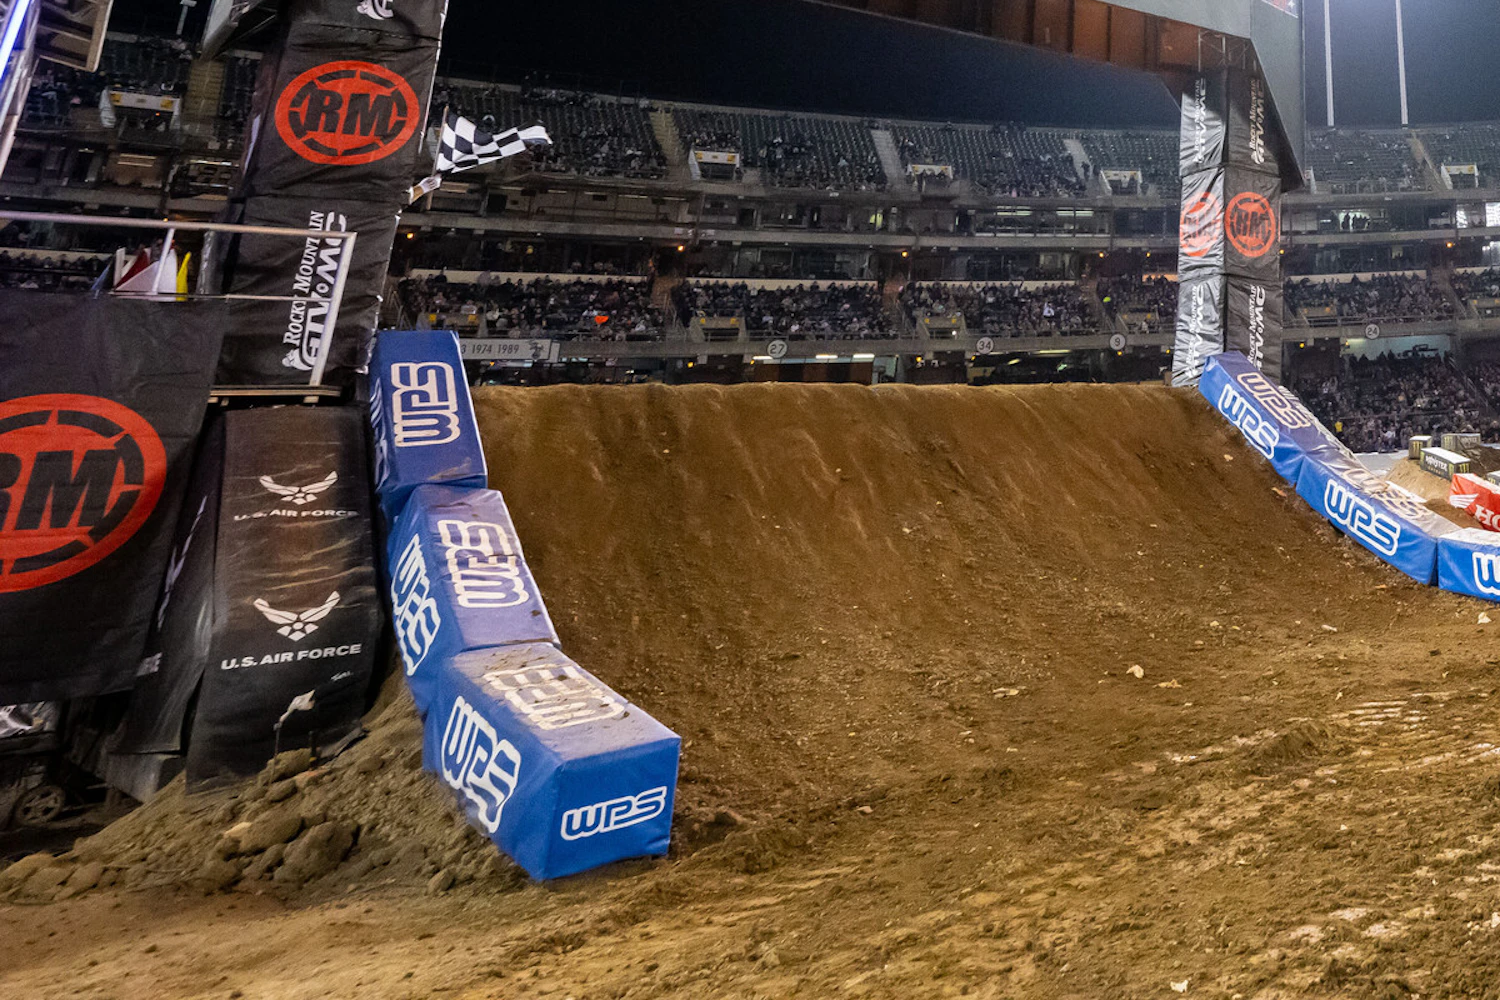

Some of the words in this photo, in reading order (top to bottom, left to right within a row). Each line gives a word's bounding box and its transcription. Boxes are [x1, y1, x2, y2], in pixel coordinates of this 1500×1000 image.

[293, 210, 325, 294] MOUNTIN
[283, 294, 308, 347] ROCKY
[978, 340, 992, 350] 34
[472, 344, 492, 355] 1974
[498, 343, 520, 355] 1989
[770, 344, 785, 355] 27
[390, 361, 461, 447] WPS
[1217, 383, 1280, 460] WPS
[1236, 371, 1311, 429] WPS
[269, 508, 298, 518] AIR
[300, 508, 361, 518] FORCE
[1324, 479, 1401, 556] WPS
[437, 519, 530, 609] WPS
[220, 656, 257, 671] U.S.
[260, 651, 296, 665] AIR
[297, 643, 362, 661] FORCE
[561, 786, 668, 841] WPS
